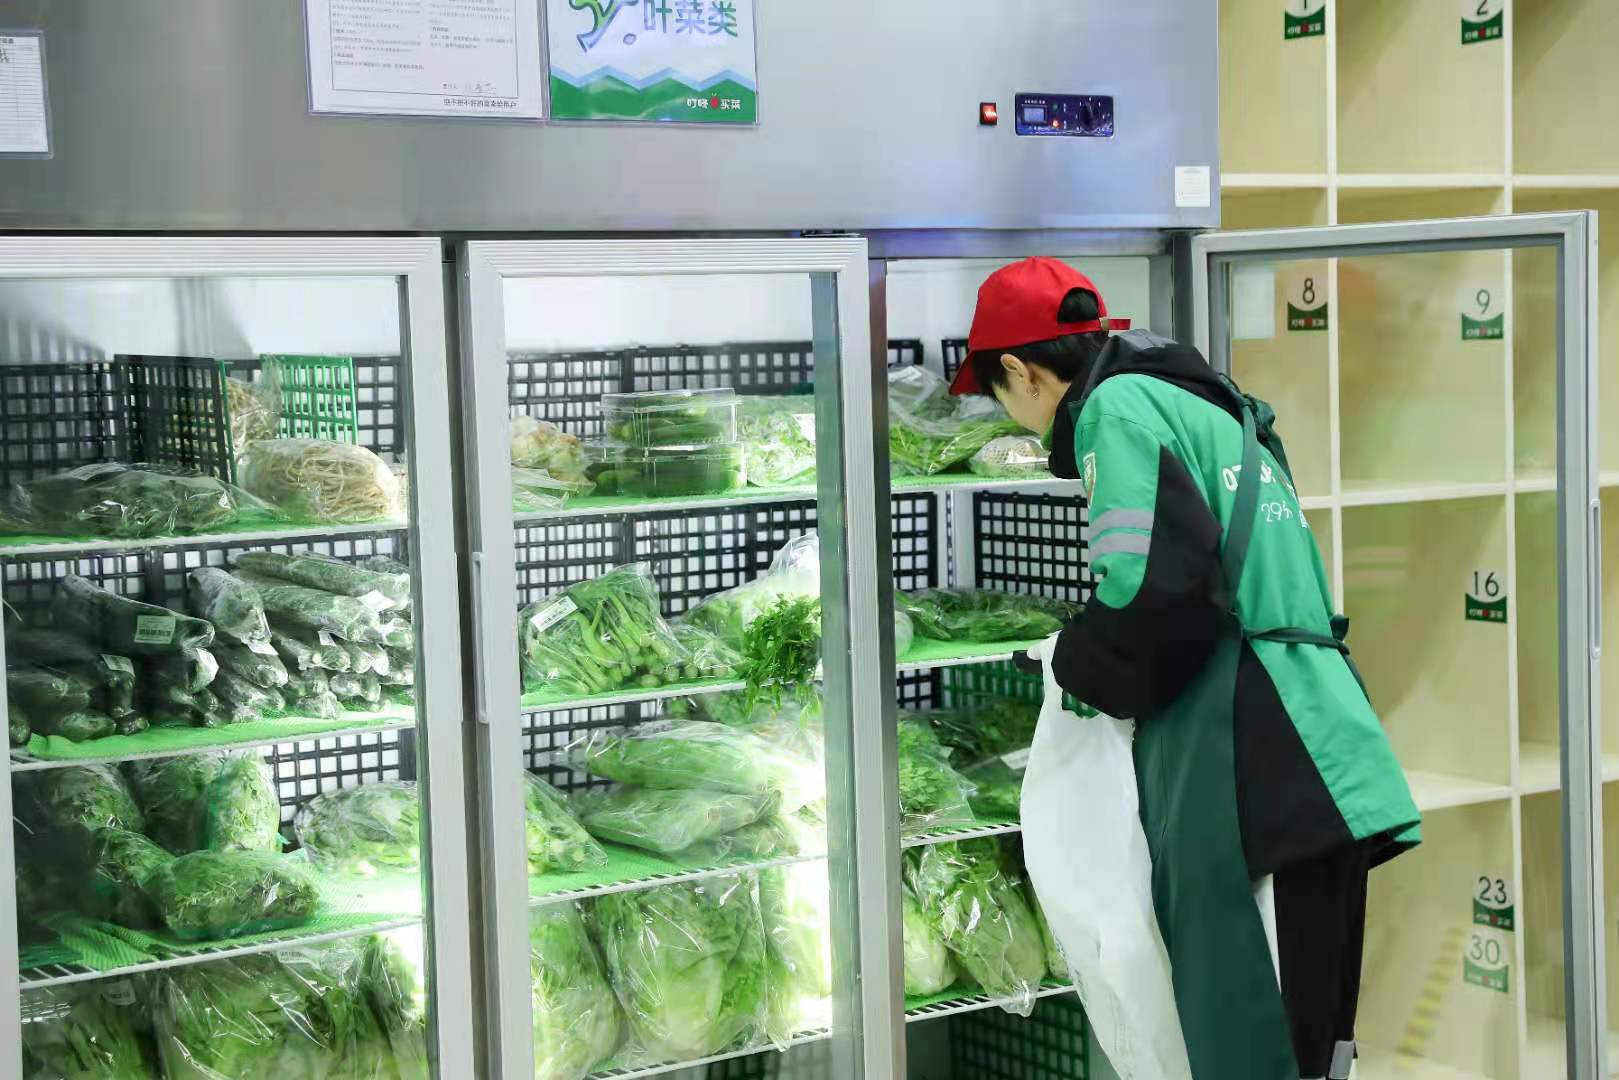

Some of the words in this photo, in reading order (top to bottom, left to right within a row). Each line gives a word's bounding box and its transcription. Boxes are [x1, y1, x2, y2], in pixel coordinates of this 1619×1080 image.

[643, 0, 738, 37] 叶菜类
[1302, 277, 1315, 304] 8
[1476, 288, 1490, 315] 9
[1474, 570, 1500, 597] 16
[1478, 876, 1507, 904] 23
[1470, 935, 1500, 965] 30
